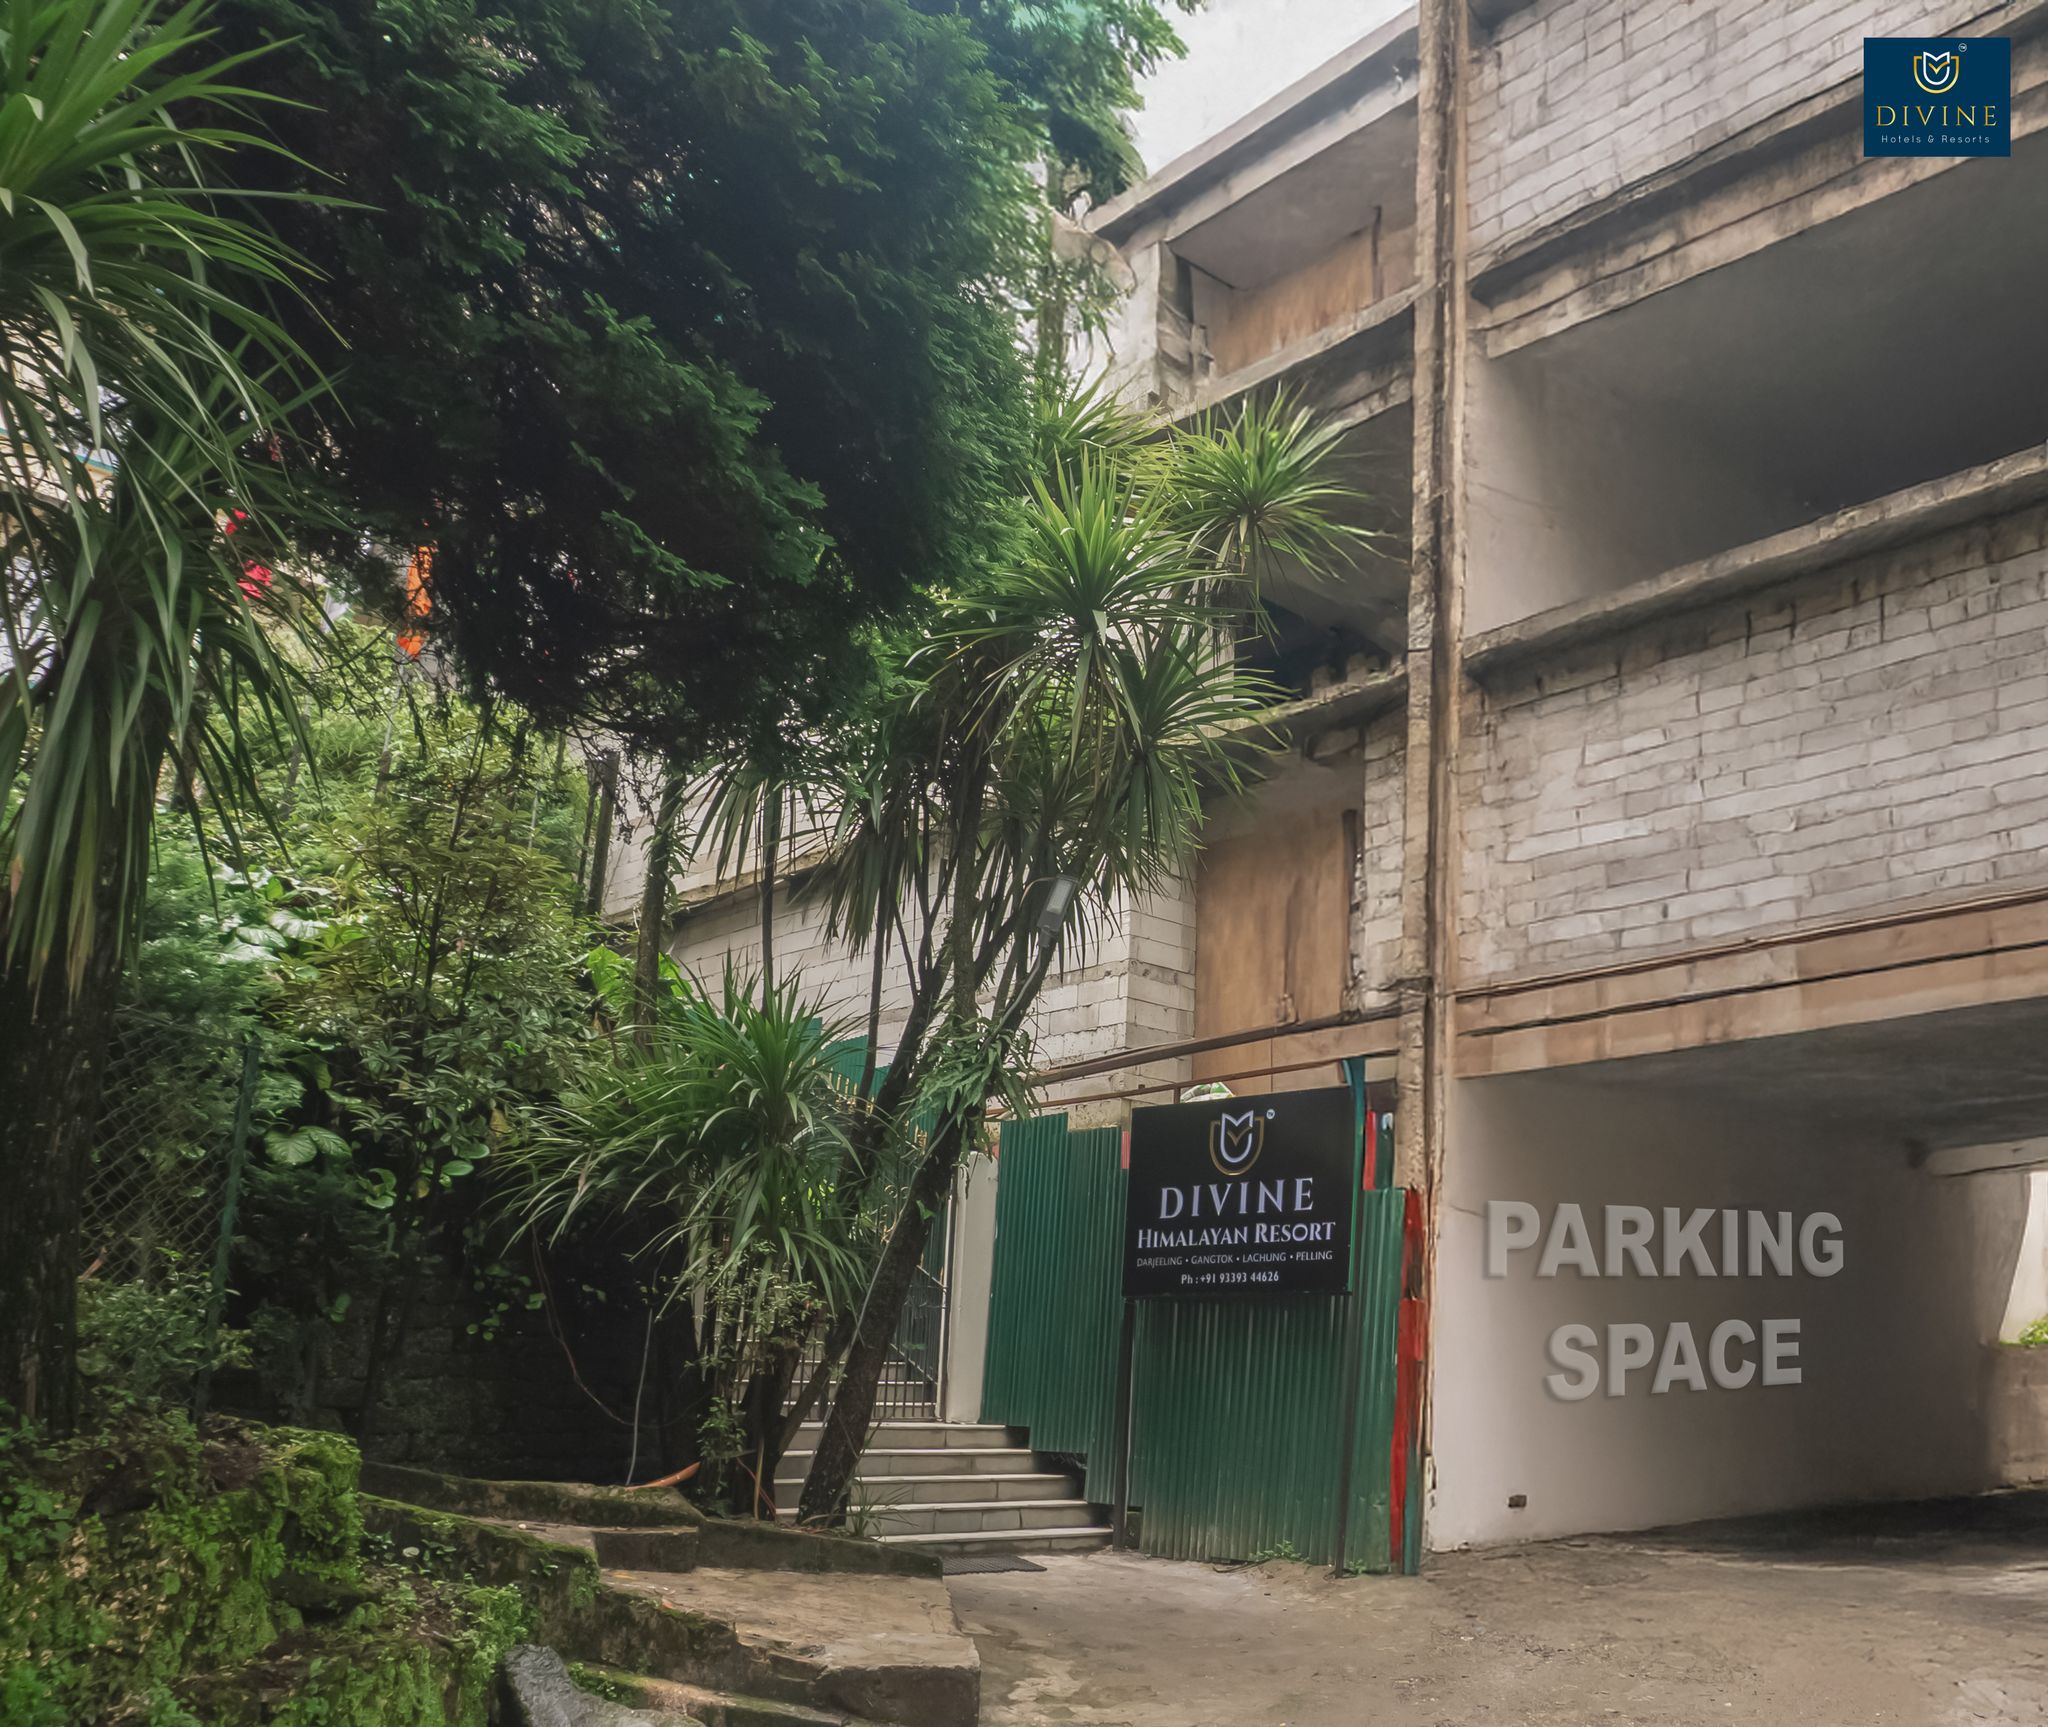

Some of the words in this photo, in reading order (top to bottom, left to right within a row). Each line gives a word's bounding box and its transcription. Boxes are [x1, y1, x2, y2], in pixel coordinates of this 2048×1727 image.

[1159, 1177, 1314, 1219] DIVINE
[1137, 1226, 1249, 1249] HIMALAYAN
[1254, 1221, 1336, 1244] RESORT
[1486, 1200, 1844, 1278] PARKING
[1136, 1257, 1183, 1269] DARJEELING
[1191, 1254, 1234, 1265] GANGTOK
[1242, 1252, 1287, 1263] LACHUNG
[1295, 1250, 1333, 1261] PELLING
[1219, 1272, 1247, 1284] 93393
[1250, 1271, 1279, 1283] 44626
[1545, 1318, 1803, 1401] SPACE
